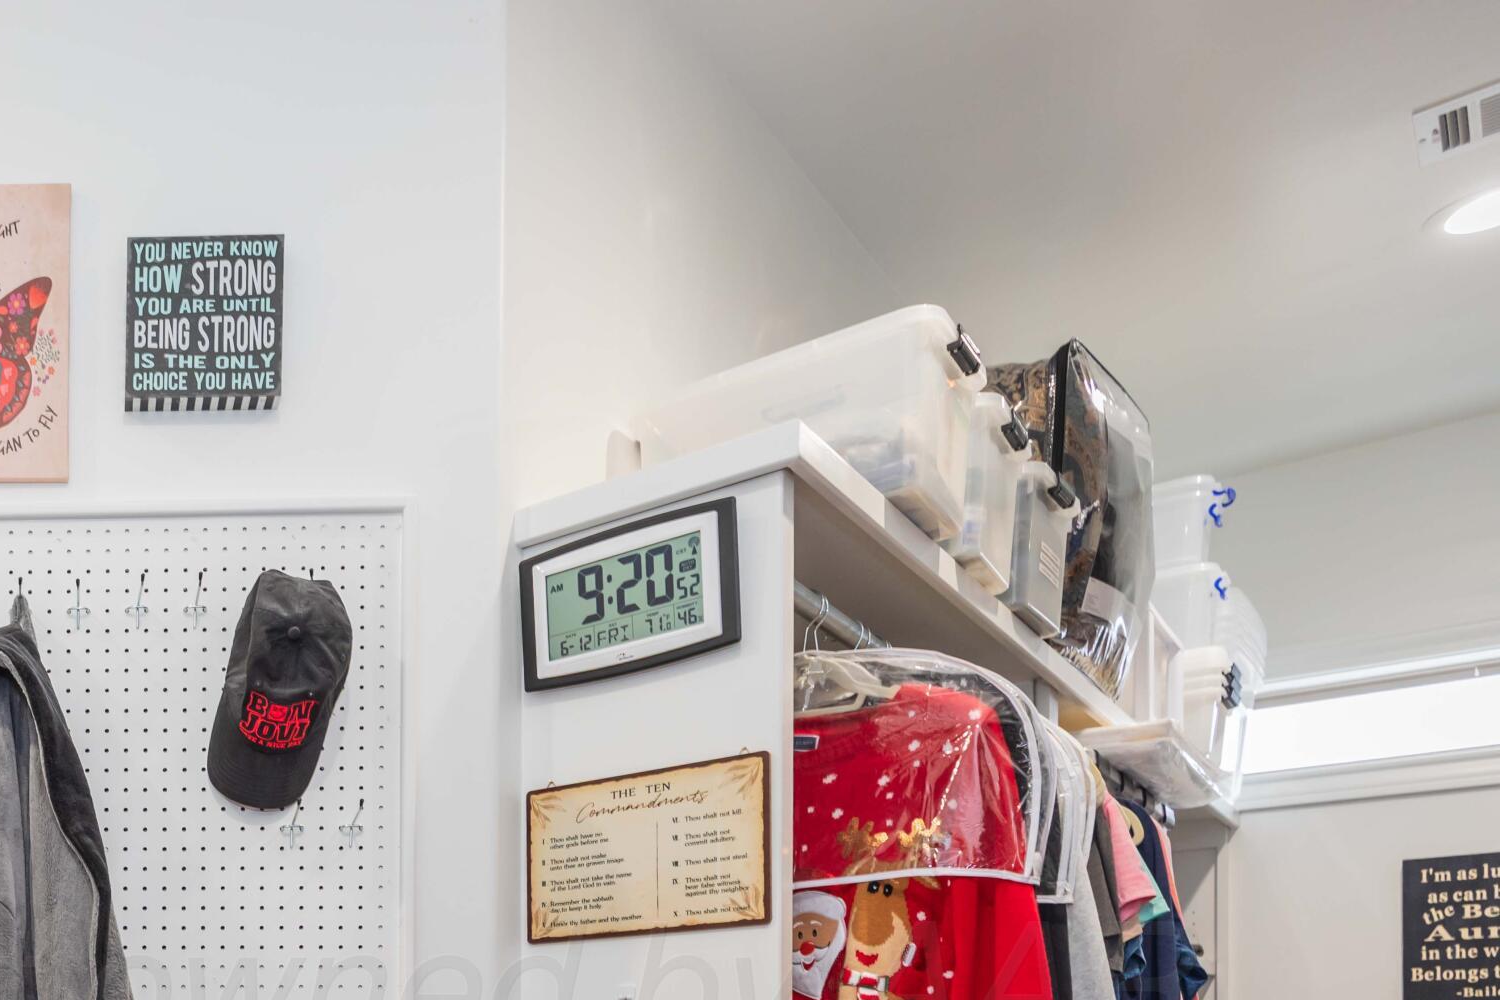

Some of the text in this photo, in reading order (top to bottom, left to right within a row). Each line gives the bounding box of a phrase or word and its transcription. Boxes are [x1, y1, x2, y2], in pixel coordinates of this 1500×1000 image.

[134, 241, 278, 263] YOU NEVER KNOW
[135, 259, 276, 296] HOW STRONG
[135, 297, 275, 316] YOU ARE UNTIL
[134, 315, 275, 353] BEING STRONG
[134, 352, 275, 369] IS THE ONLY
[133, 371, 275, 390] CHOICE YOU HAVE
[23, 429, 40, 443] TO
[39, 405, 58, 430] FLY
[550, 544, 700, 625] AM 9:20 52
[598, 625, 628, 647] FRI
[239, 712, 310, 742] JOVI
[611, 782, 671, 800] THE TEN
[575, 789, 709, 824] Commandments
[1421, 868, 1451, 883] I'm
[1457, 869, 1477, 881] as
[1428, 892, 1448, 904] as
[1453, 889, 1487, 902] can
[1423, 905, 1455, 925] the
[1421, 946, 1440, 961] in
[1446, 944, 1478, 960] the
[1411, 966, 1489, 983] Belongs
